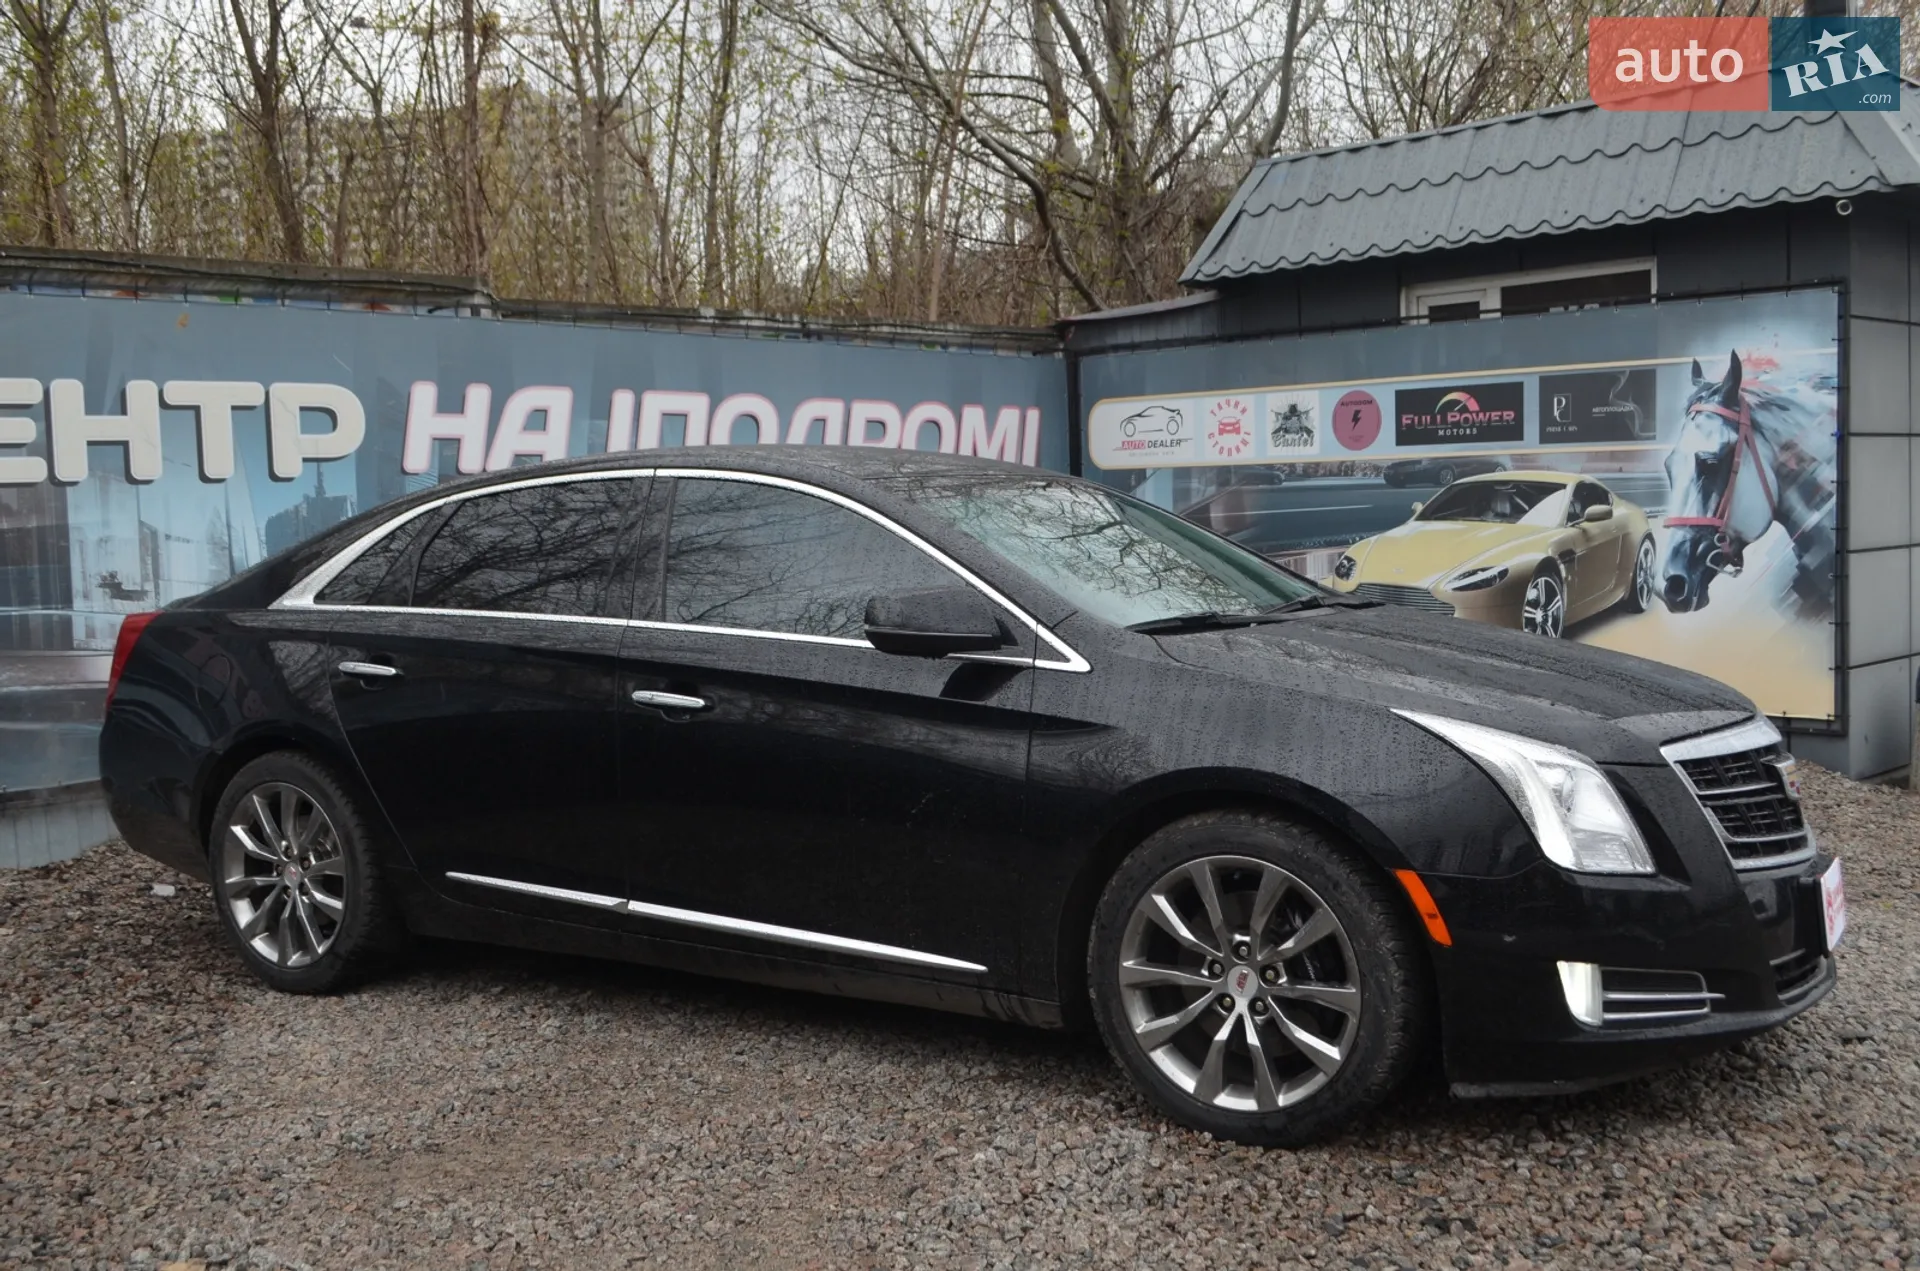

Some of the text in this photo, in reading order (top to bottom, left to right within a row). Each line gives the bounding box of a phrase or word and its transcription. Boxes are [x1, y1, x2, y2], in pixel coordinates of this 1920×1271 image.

[0, 377, 366, 485] ЕНТР
[402, 380, 574, 475] НА
[1437, 427, 1478, 436] MOTORS
[1121, 438, 1182, 450] AUTO DEALER
